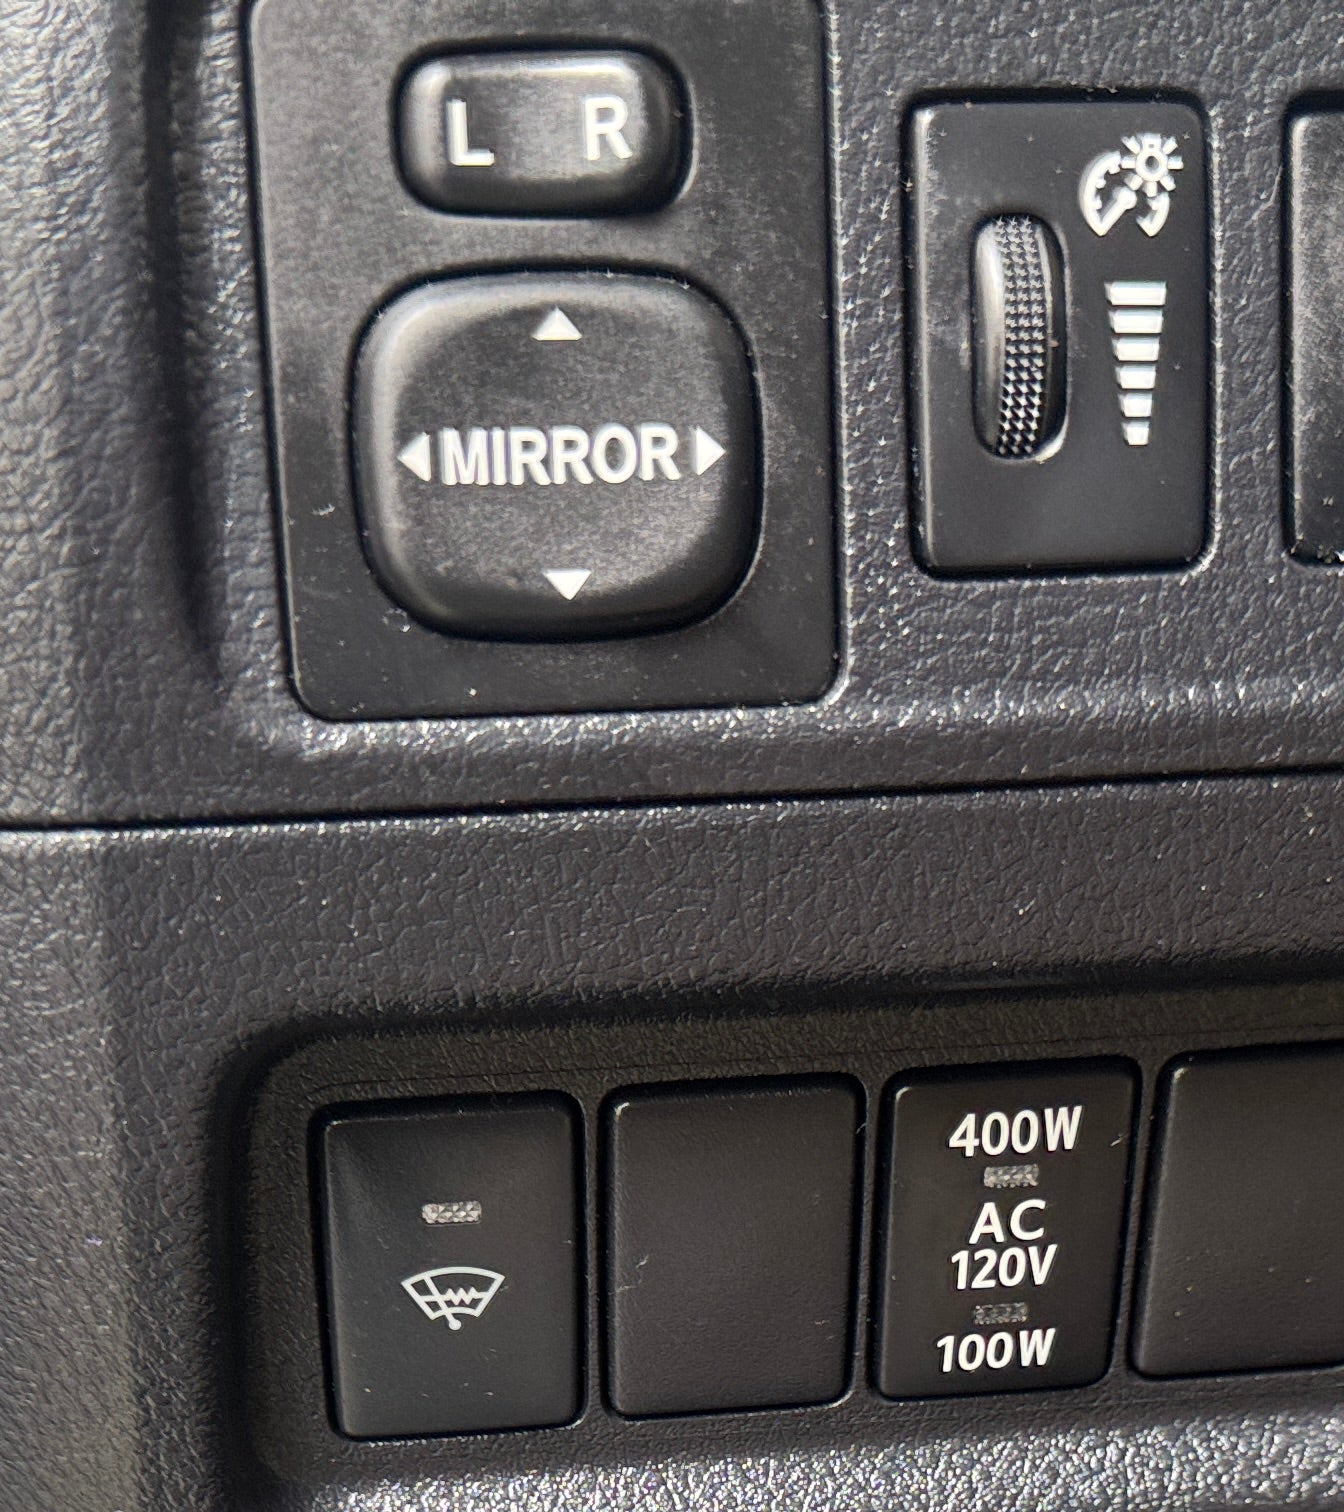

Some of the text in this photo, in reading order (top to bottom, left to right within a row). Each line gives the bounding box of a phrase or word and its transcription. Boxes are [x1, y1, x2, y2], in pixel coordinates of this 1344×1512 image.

[446, 95, 633, 166] L R
[439, 422, 682, 486] MIRROR
[948, 1105, 1082, 1157] 400W
[968, 1199, 1046, 1245] AC
[951, 1244, 1058, 1290] 120V
[936, 1328, 1056, 1373] 100W
